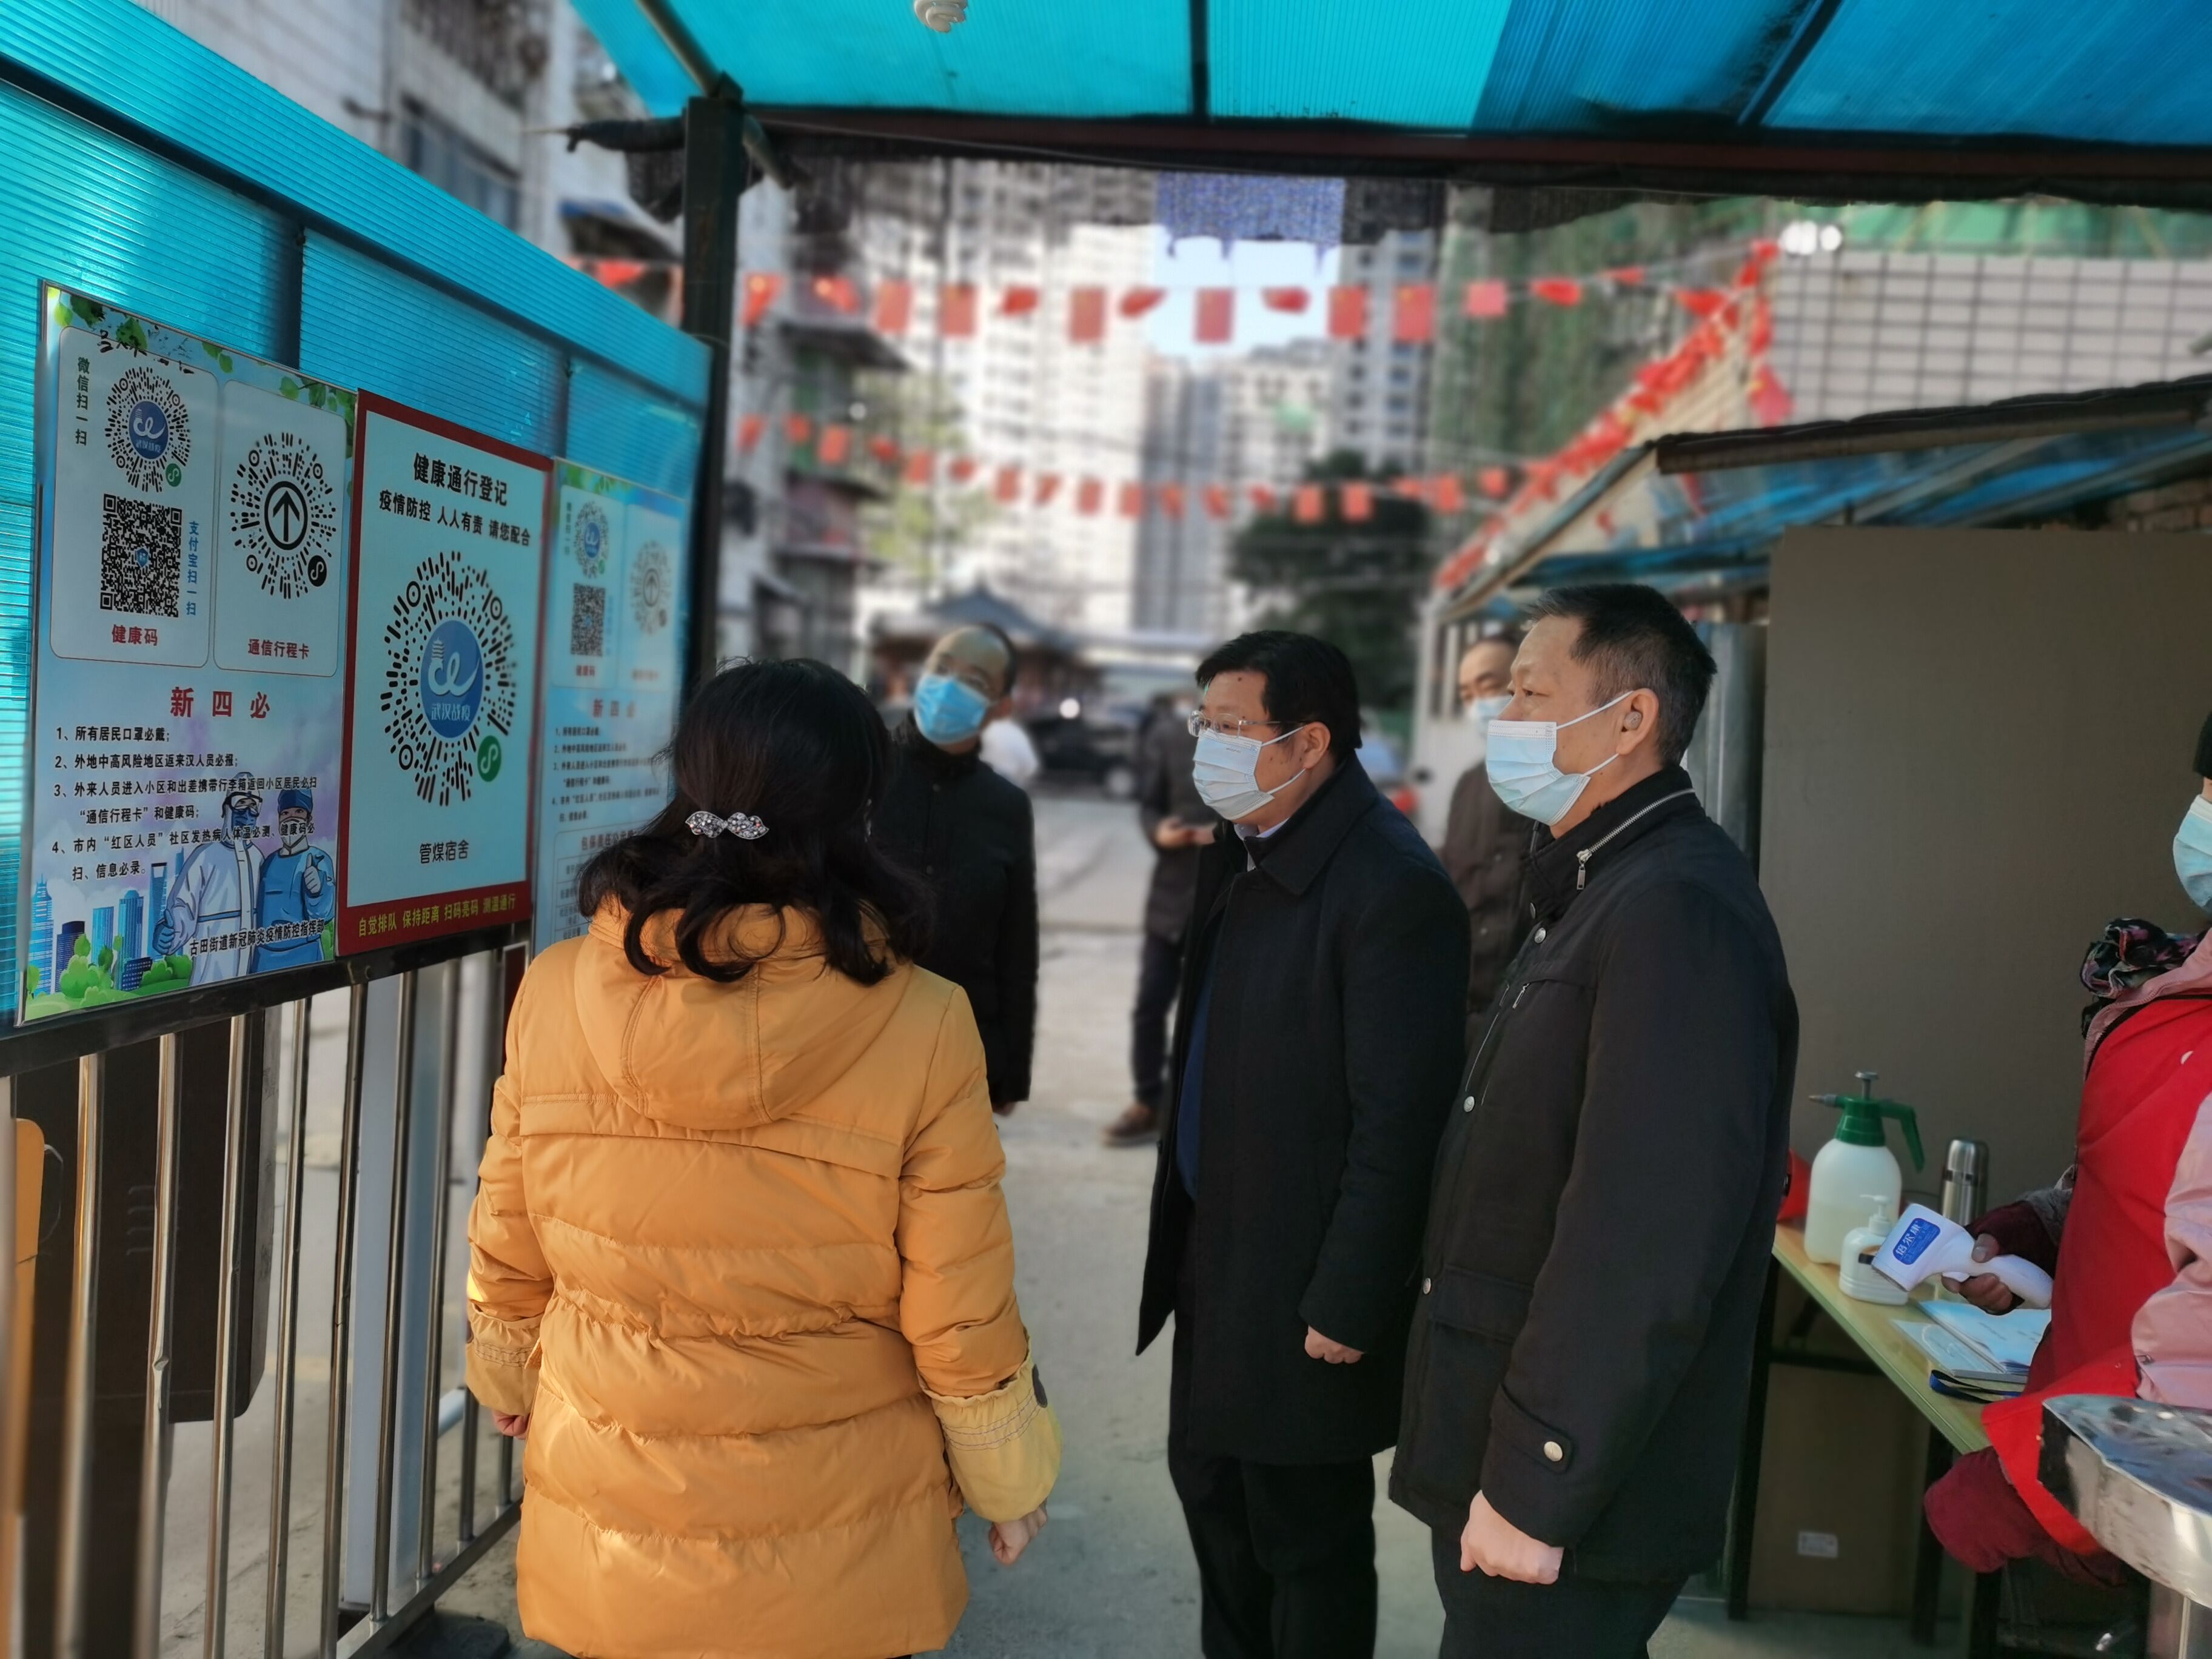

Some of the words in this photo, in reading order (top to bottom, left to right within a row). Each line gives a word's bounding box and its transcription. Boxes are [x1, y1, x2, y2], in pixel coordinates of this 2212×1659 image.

[75, 357, 90, 446] 微信扫一扫
[414, 452, 507, 507] 健康通行登记
[380, 489, 431, 521] 疫情防控
[437, 506, 483, 535] 人人有责
[489, 519, 531, 546] 请您配合
[186, 521, 199, 615] 支付宝扫一扫
[112, 624, 158, 646] 健康码
[248, 638, 309, 660] 通信行程卡
[431, 703, 471, 722] 武汉战疫
[419, 839, 469, 864] 管煤宿舍
[358, 912, 397, 937] 自觉排队
[403, 905, 440, 928] 保持距离
[444, 899, 478, 921] 扫码亮码
[483, 893, 515, 913] 测温通行
[189, 919, 325, 957] 古田街道新冠肺炎疫情防控指挥部
